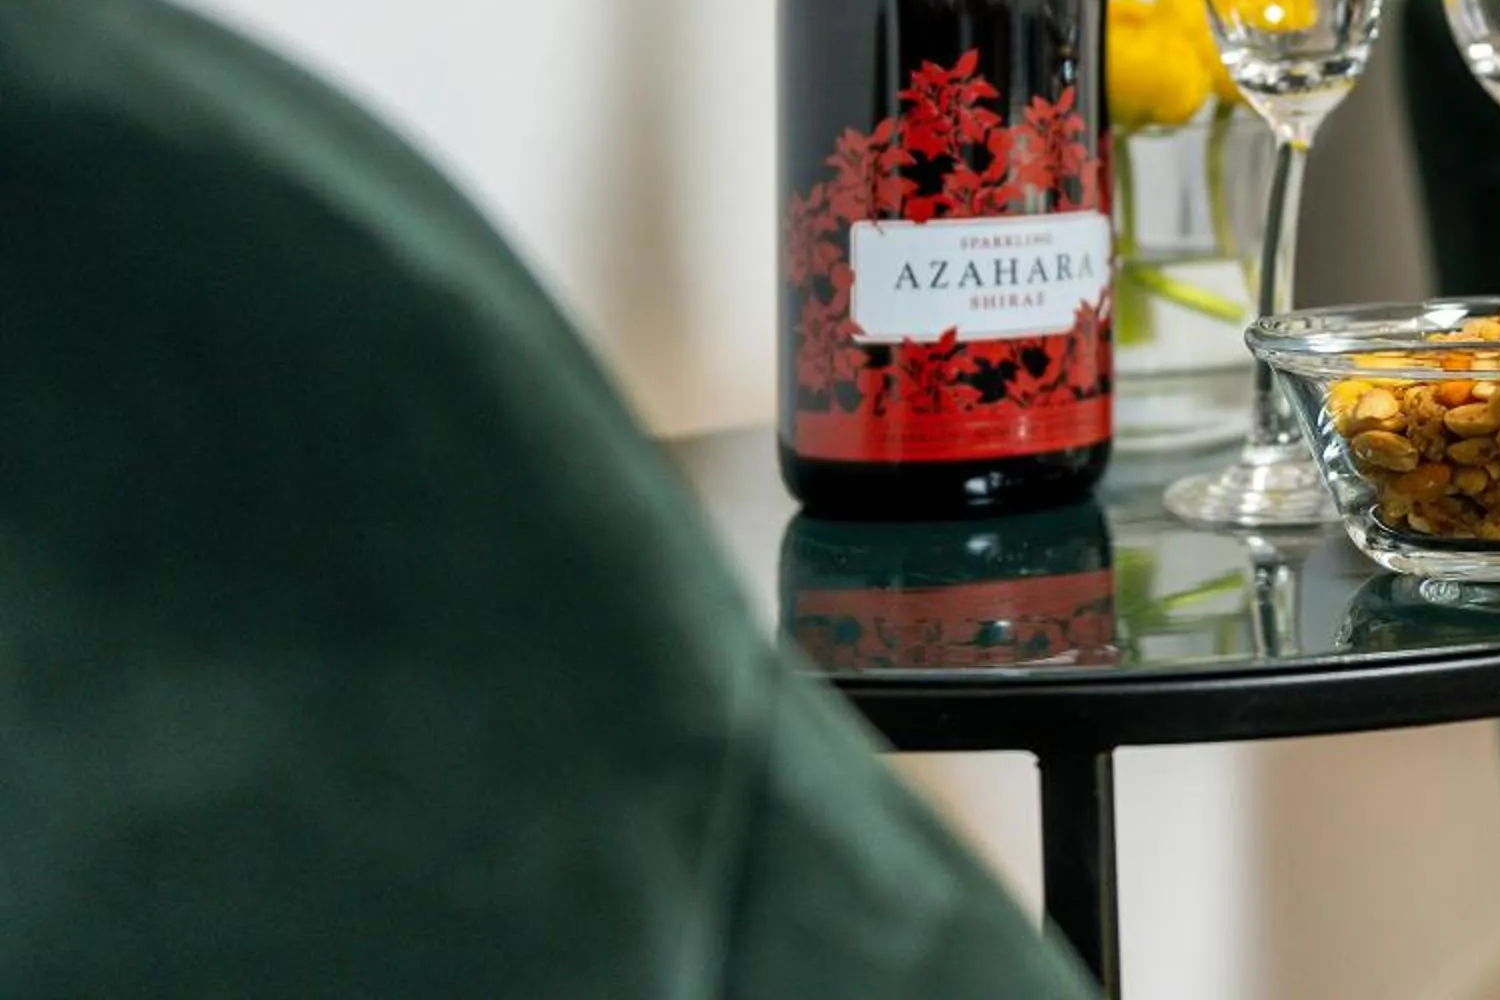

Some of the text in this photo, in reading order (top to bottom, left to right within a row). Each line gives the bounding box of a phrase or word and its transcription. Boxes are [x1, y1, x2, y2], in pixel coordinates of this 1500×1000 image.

[960, 231, 1052, 251] SPARKLING
[894, 252, 1095, 290] AZAHARA
[969, 291, 1045, 311] SHIRAZ
